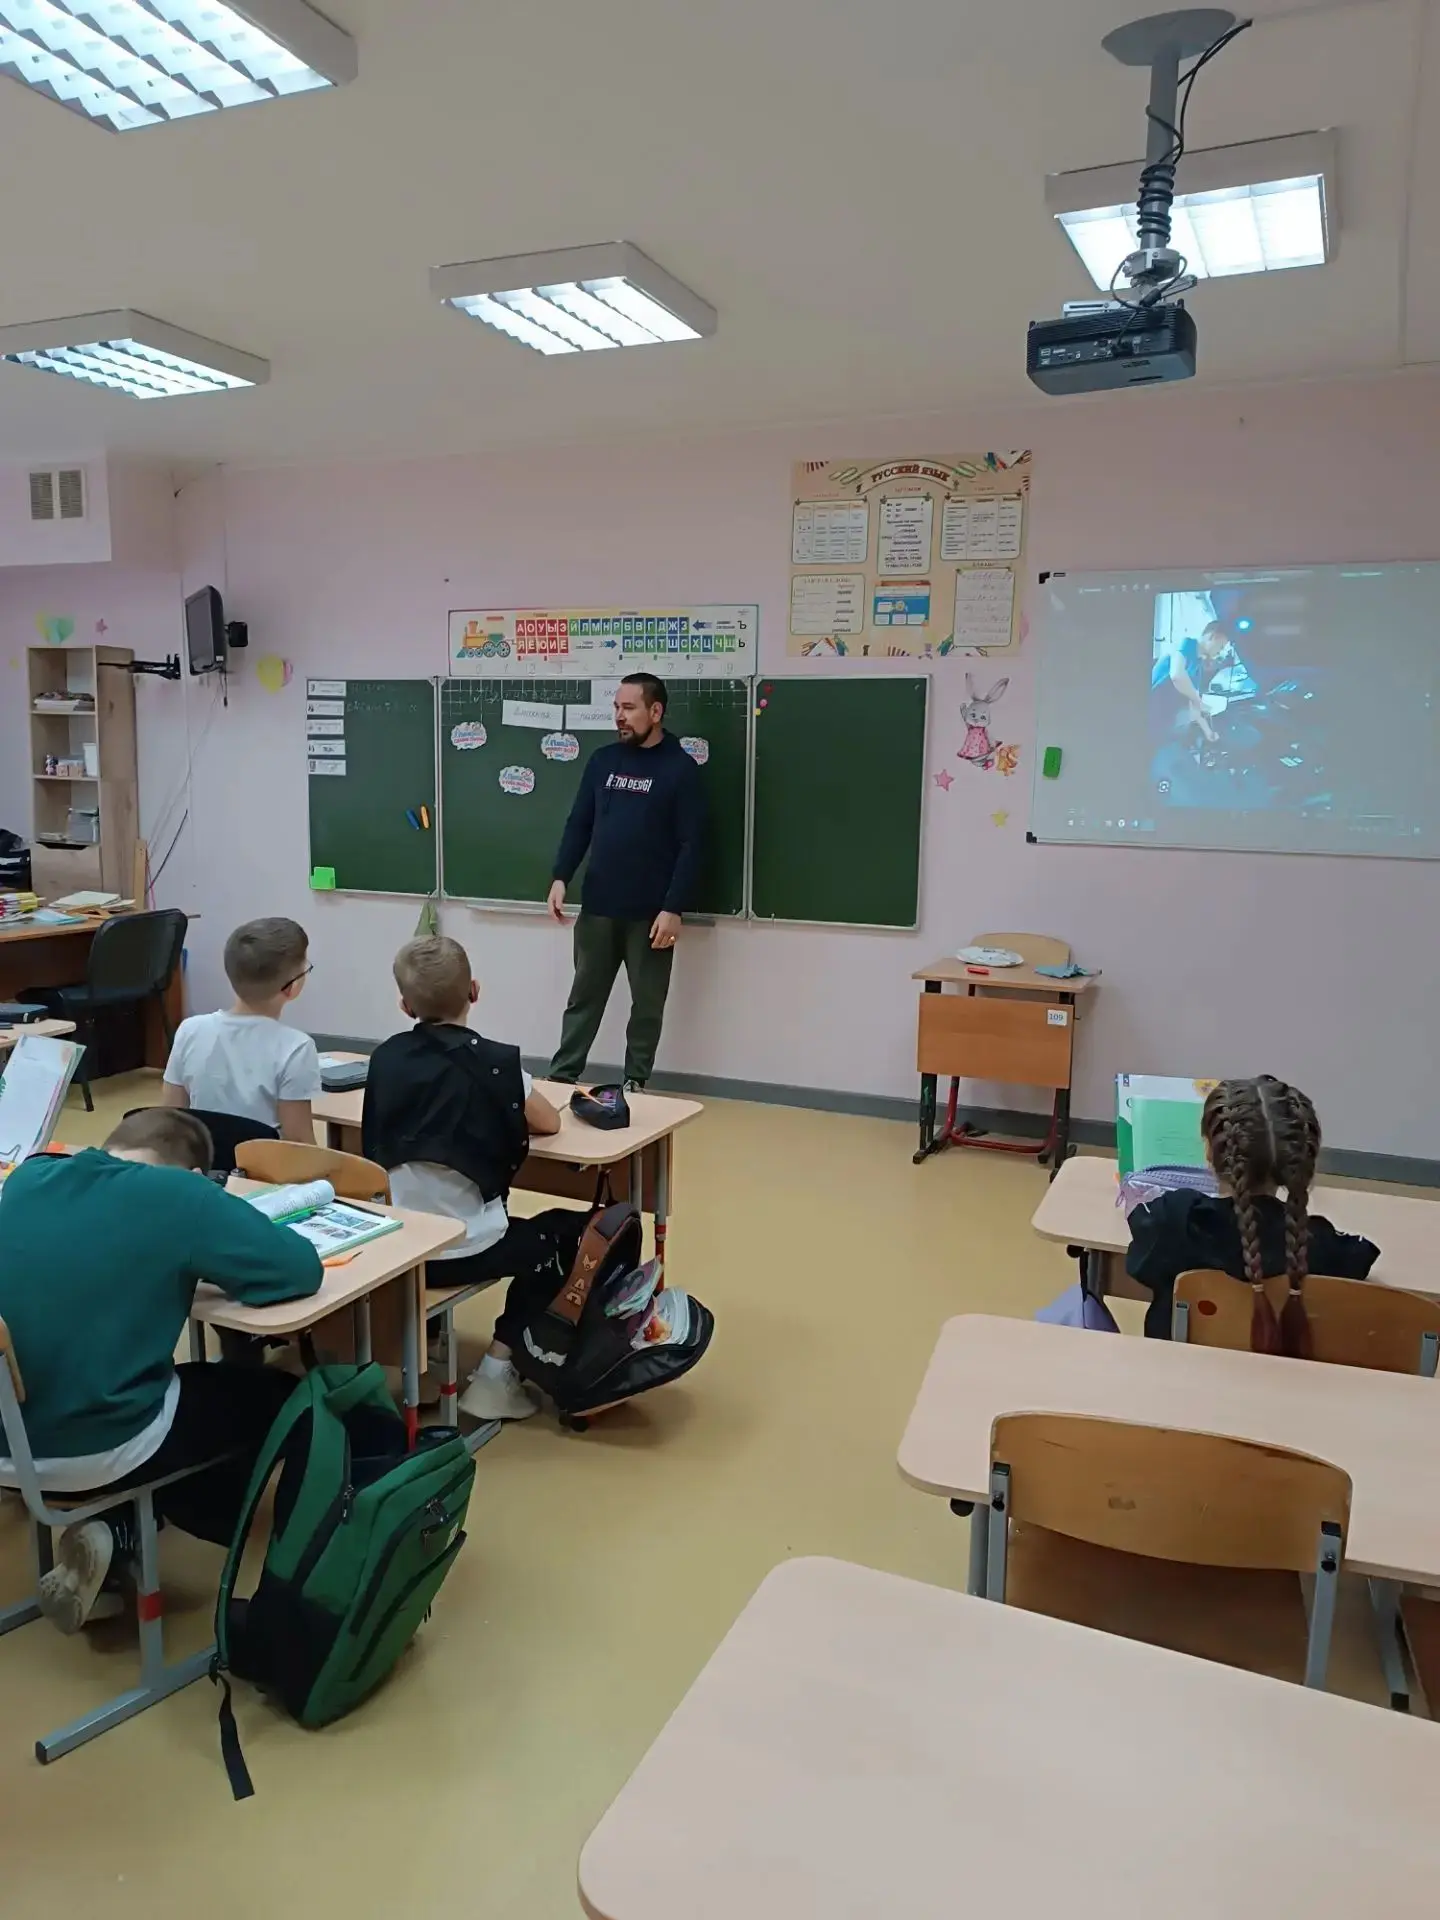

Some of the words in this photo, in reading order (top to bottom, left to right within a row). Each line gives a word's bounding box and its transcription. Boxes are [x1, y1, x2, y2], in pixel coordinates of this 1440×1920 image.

[870, 464, 920, 482] РУССКИЙ
[920, 466, 950, 482] ЯЗЫК
[1048, 1013, 1064, 1021] 109
